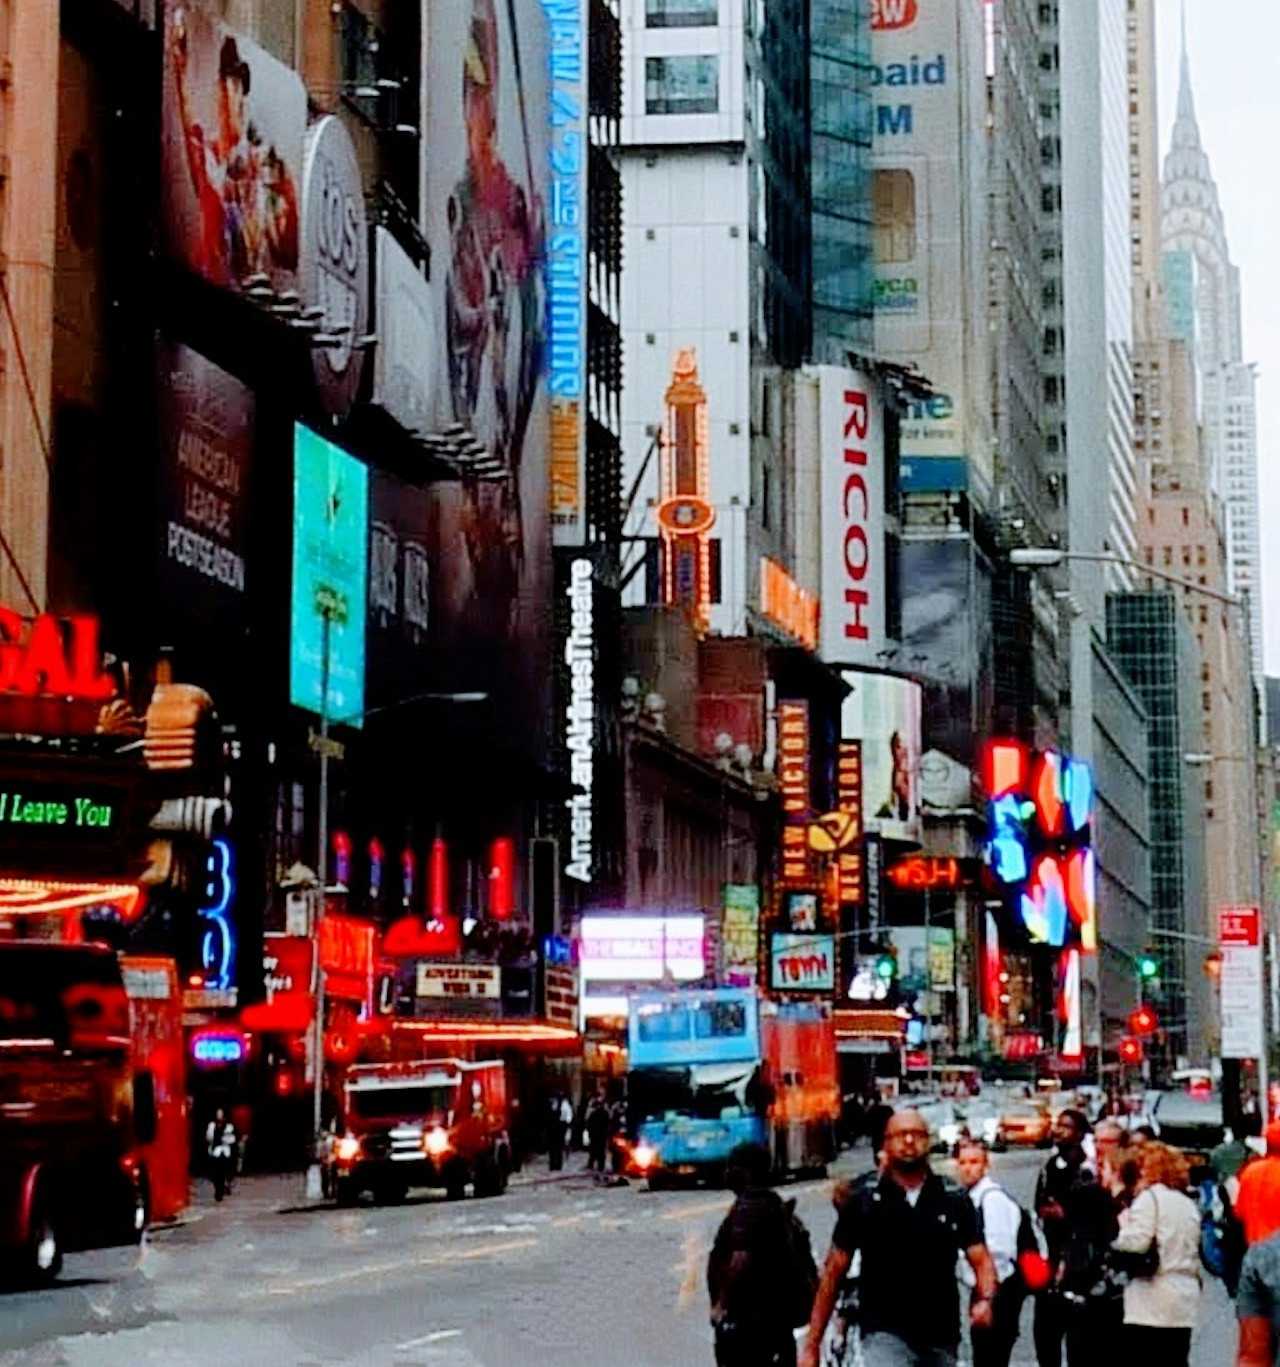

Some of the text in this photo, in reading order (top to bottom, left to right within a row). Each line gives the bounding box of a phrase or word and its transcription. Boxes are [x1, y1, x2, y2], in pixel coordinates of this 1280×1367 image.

[842, 389, 869, 641] RICOH
[10, 794, 68, 825] Leave
[74, 798, 112, 827] You
[783, 704, 807, 877] NEW VICTORY
[839, 852, 860, 902] NEW
